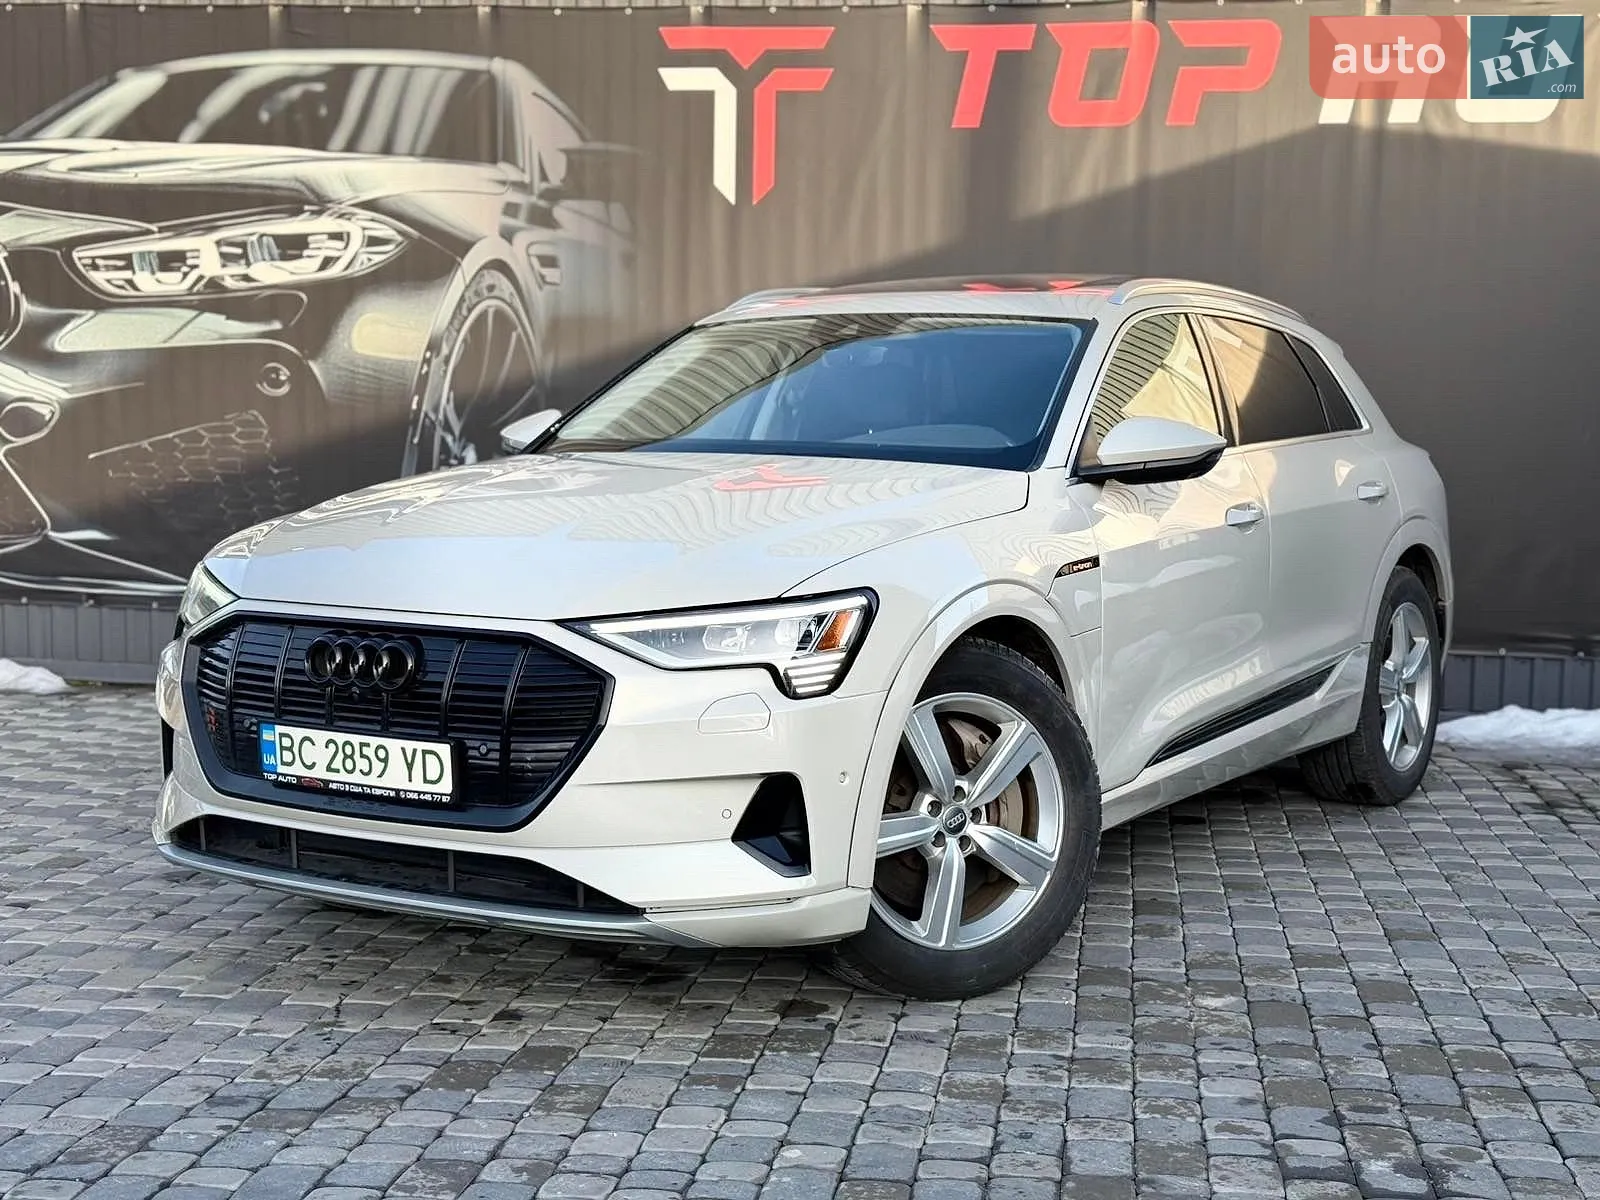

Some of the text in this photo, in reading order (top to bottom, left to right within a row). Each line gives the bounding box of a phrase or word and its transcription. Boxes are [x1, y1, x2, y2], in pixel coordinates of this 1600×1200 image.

[930, 19, 1282, 128] TOP
[263, 753, 278, 766] UA
[278, 732, 445, 786] BC 2859 YD
[263, 772, 298, 784] TOP AUTO
